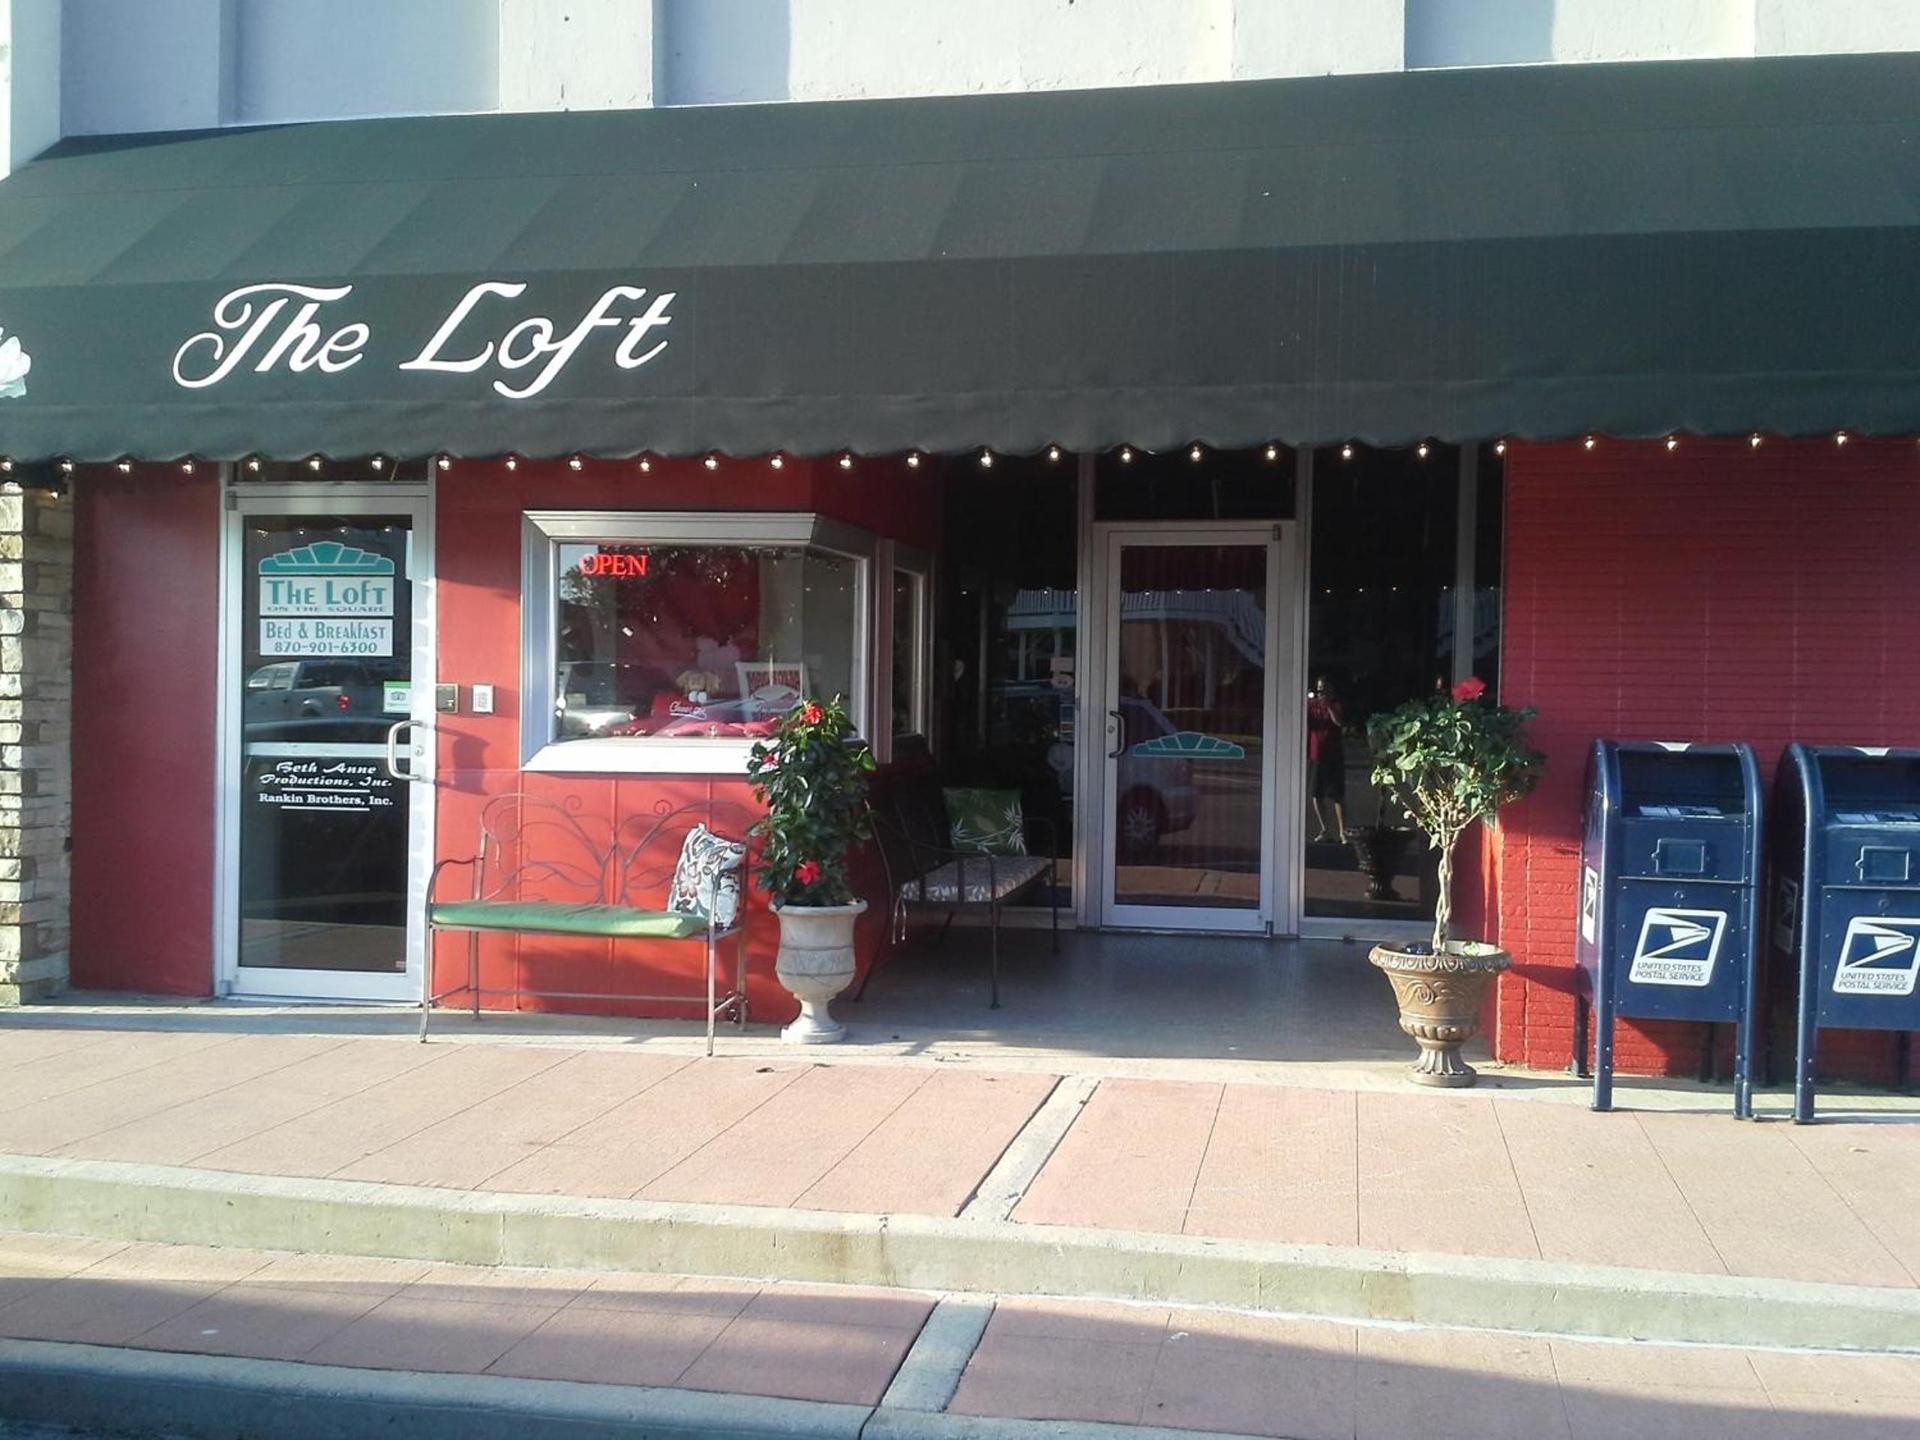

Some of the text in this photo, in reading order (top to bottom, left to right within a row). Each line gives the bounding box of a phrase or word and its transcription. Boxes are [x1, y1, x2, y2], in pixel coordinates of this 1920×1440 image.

[173, 281, 677, 399] The Loft
[578, 553, 649, 576] OPEN
[298, 622, 309, 639] &
[274, 641, 378, 654] 870-901-6300
[276, 761, 377, 775] Beth Anne
[259, 774, 393, 787] Productions, Inc.
[259, 793, 394, 806] Rankin Brothers, Inc.
[1637, 962, 1703, 972] UNITED STATES
[1634, 971, 1705, 981] POSTAL SERVICE
[1840, 972, 1906, 981] UNITED STATES
[1838, 981, 1909, 990] POSTAL SERVICE
